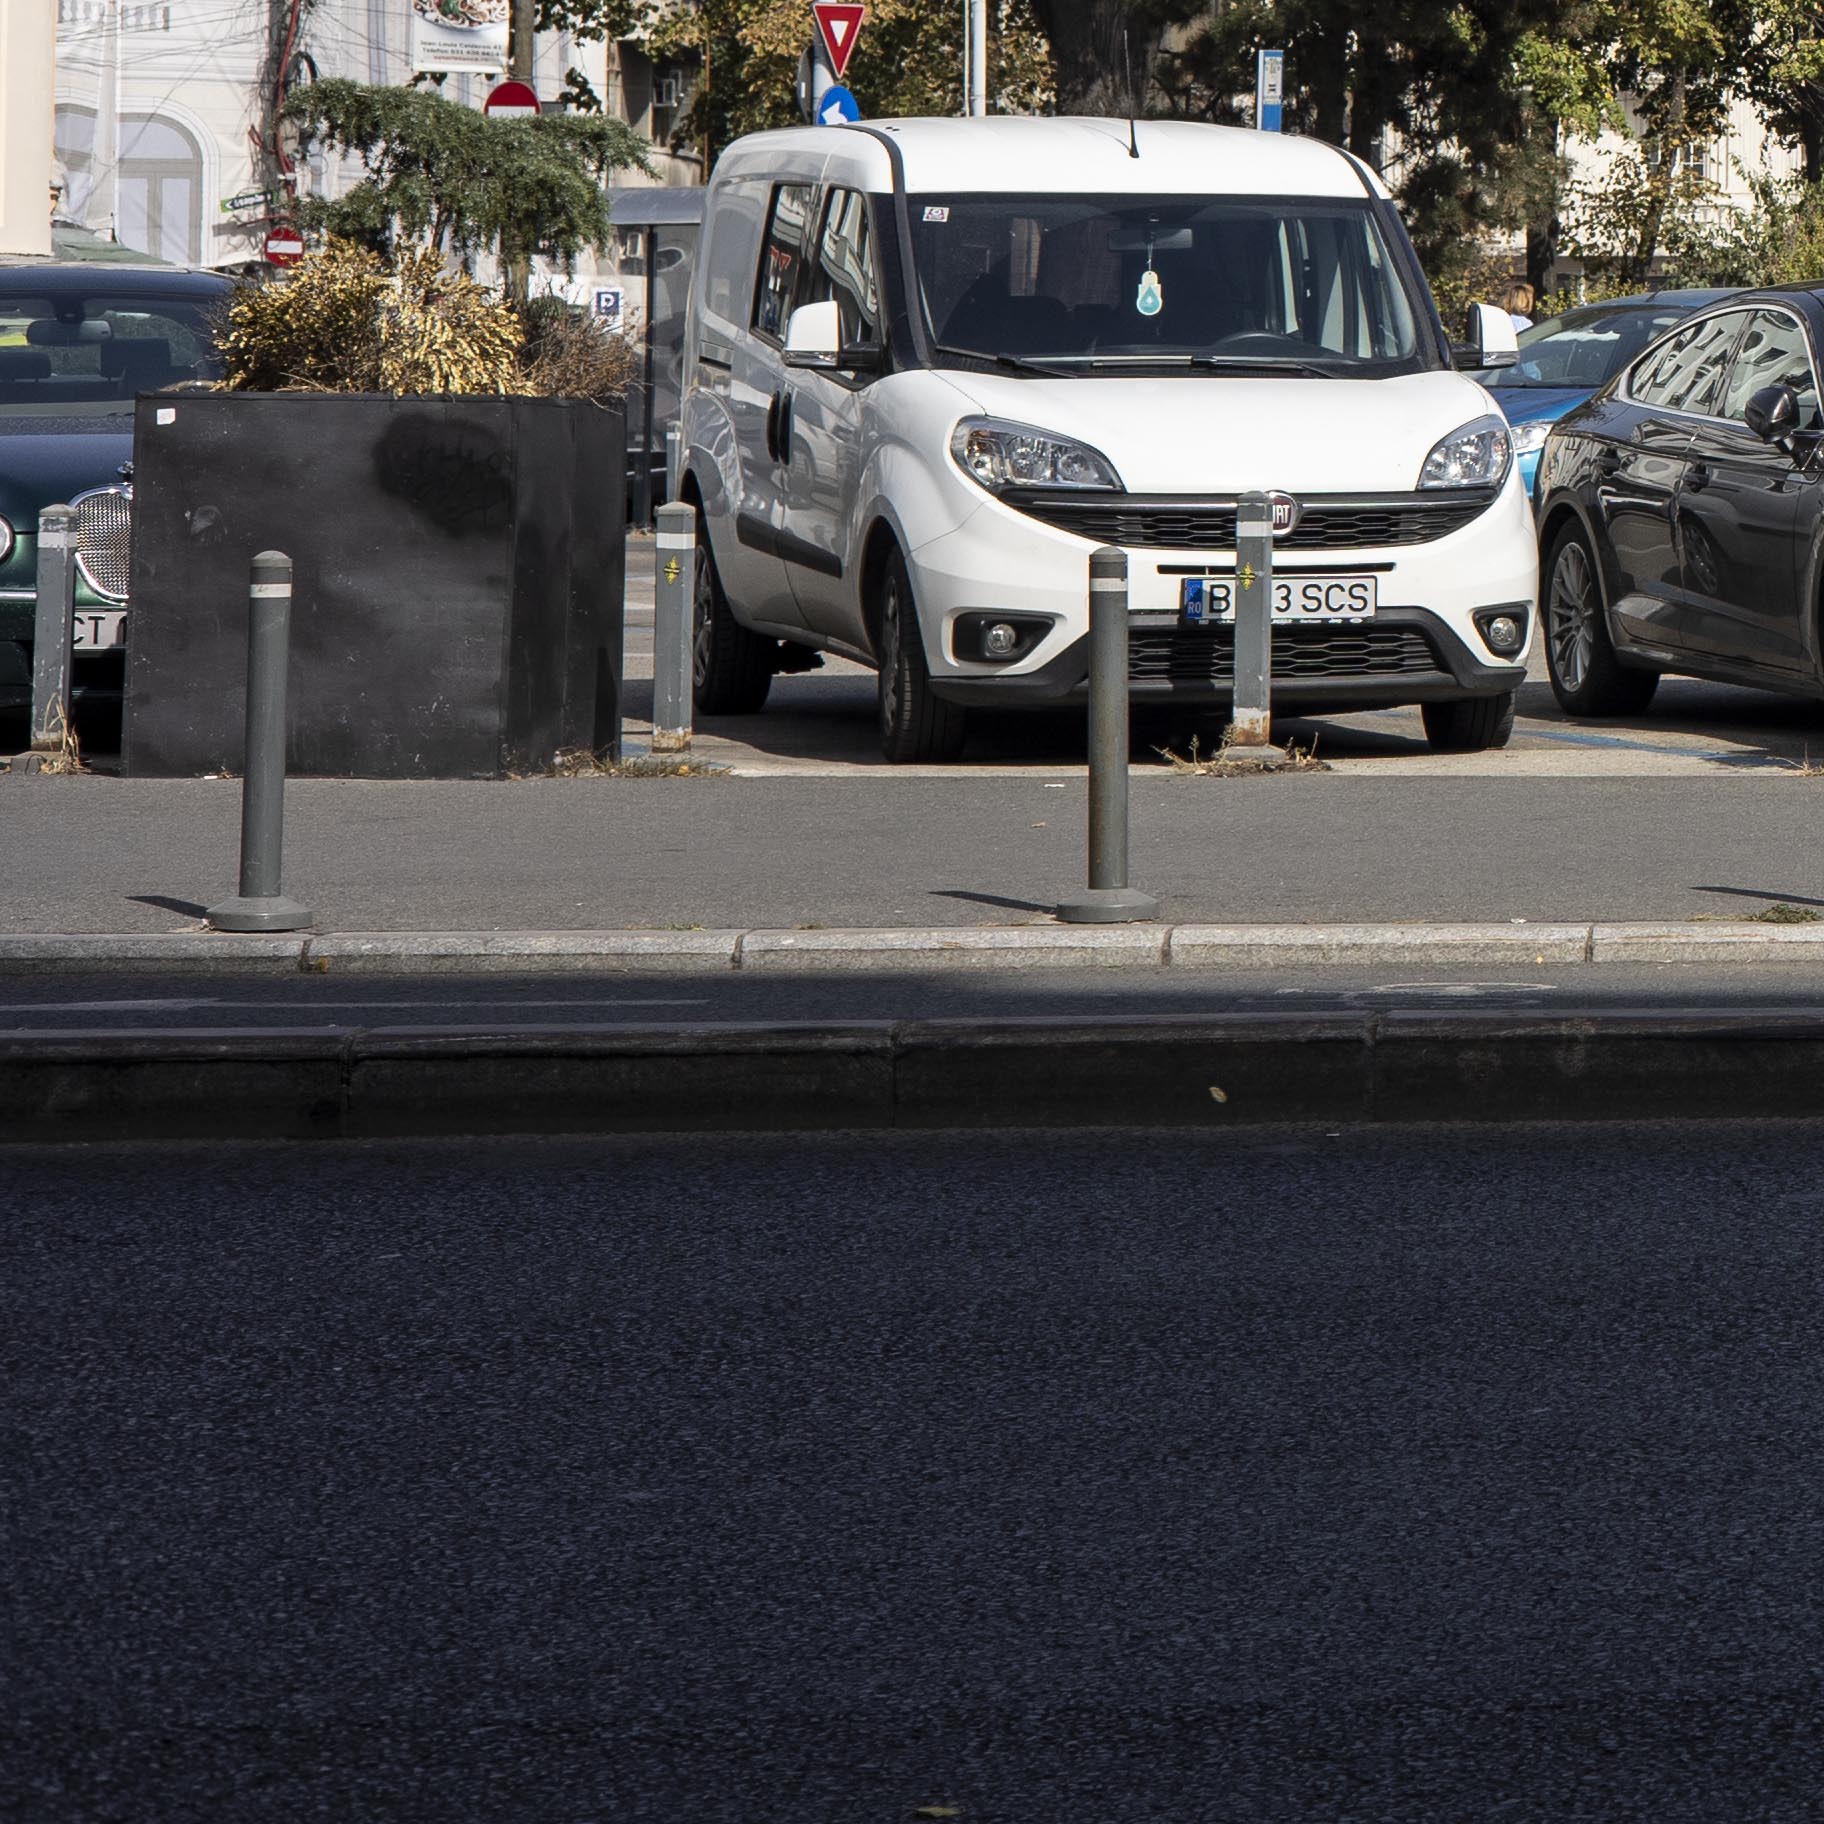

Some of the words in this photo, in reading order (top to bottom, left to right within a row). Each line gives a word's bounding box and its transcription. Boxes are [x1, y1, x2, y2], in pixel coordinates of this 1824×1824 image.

[600, 293, 615, 313] P
[1273, 505, 1289, 523] IAT
[1188, 601, 1201, 613] RO
[1209, 584, 1230, 613] B
[1302, 583, 1368, 612] SCS
